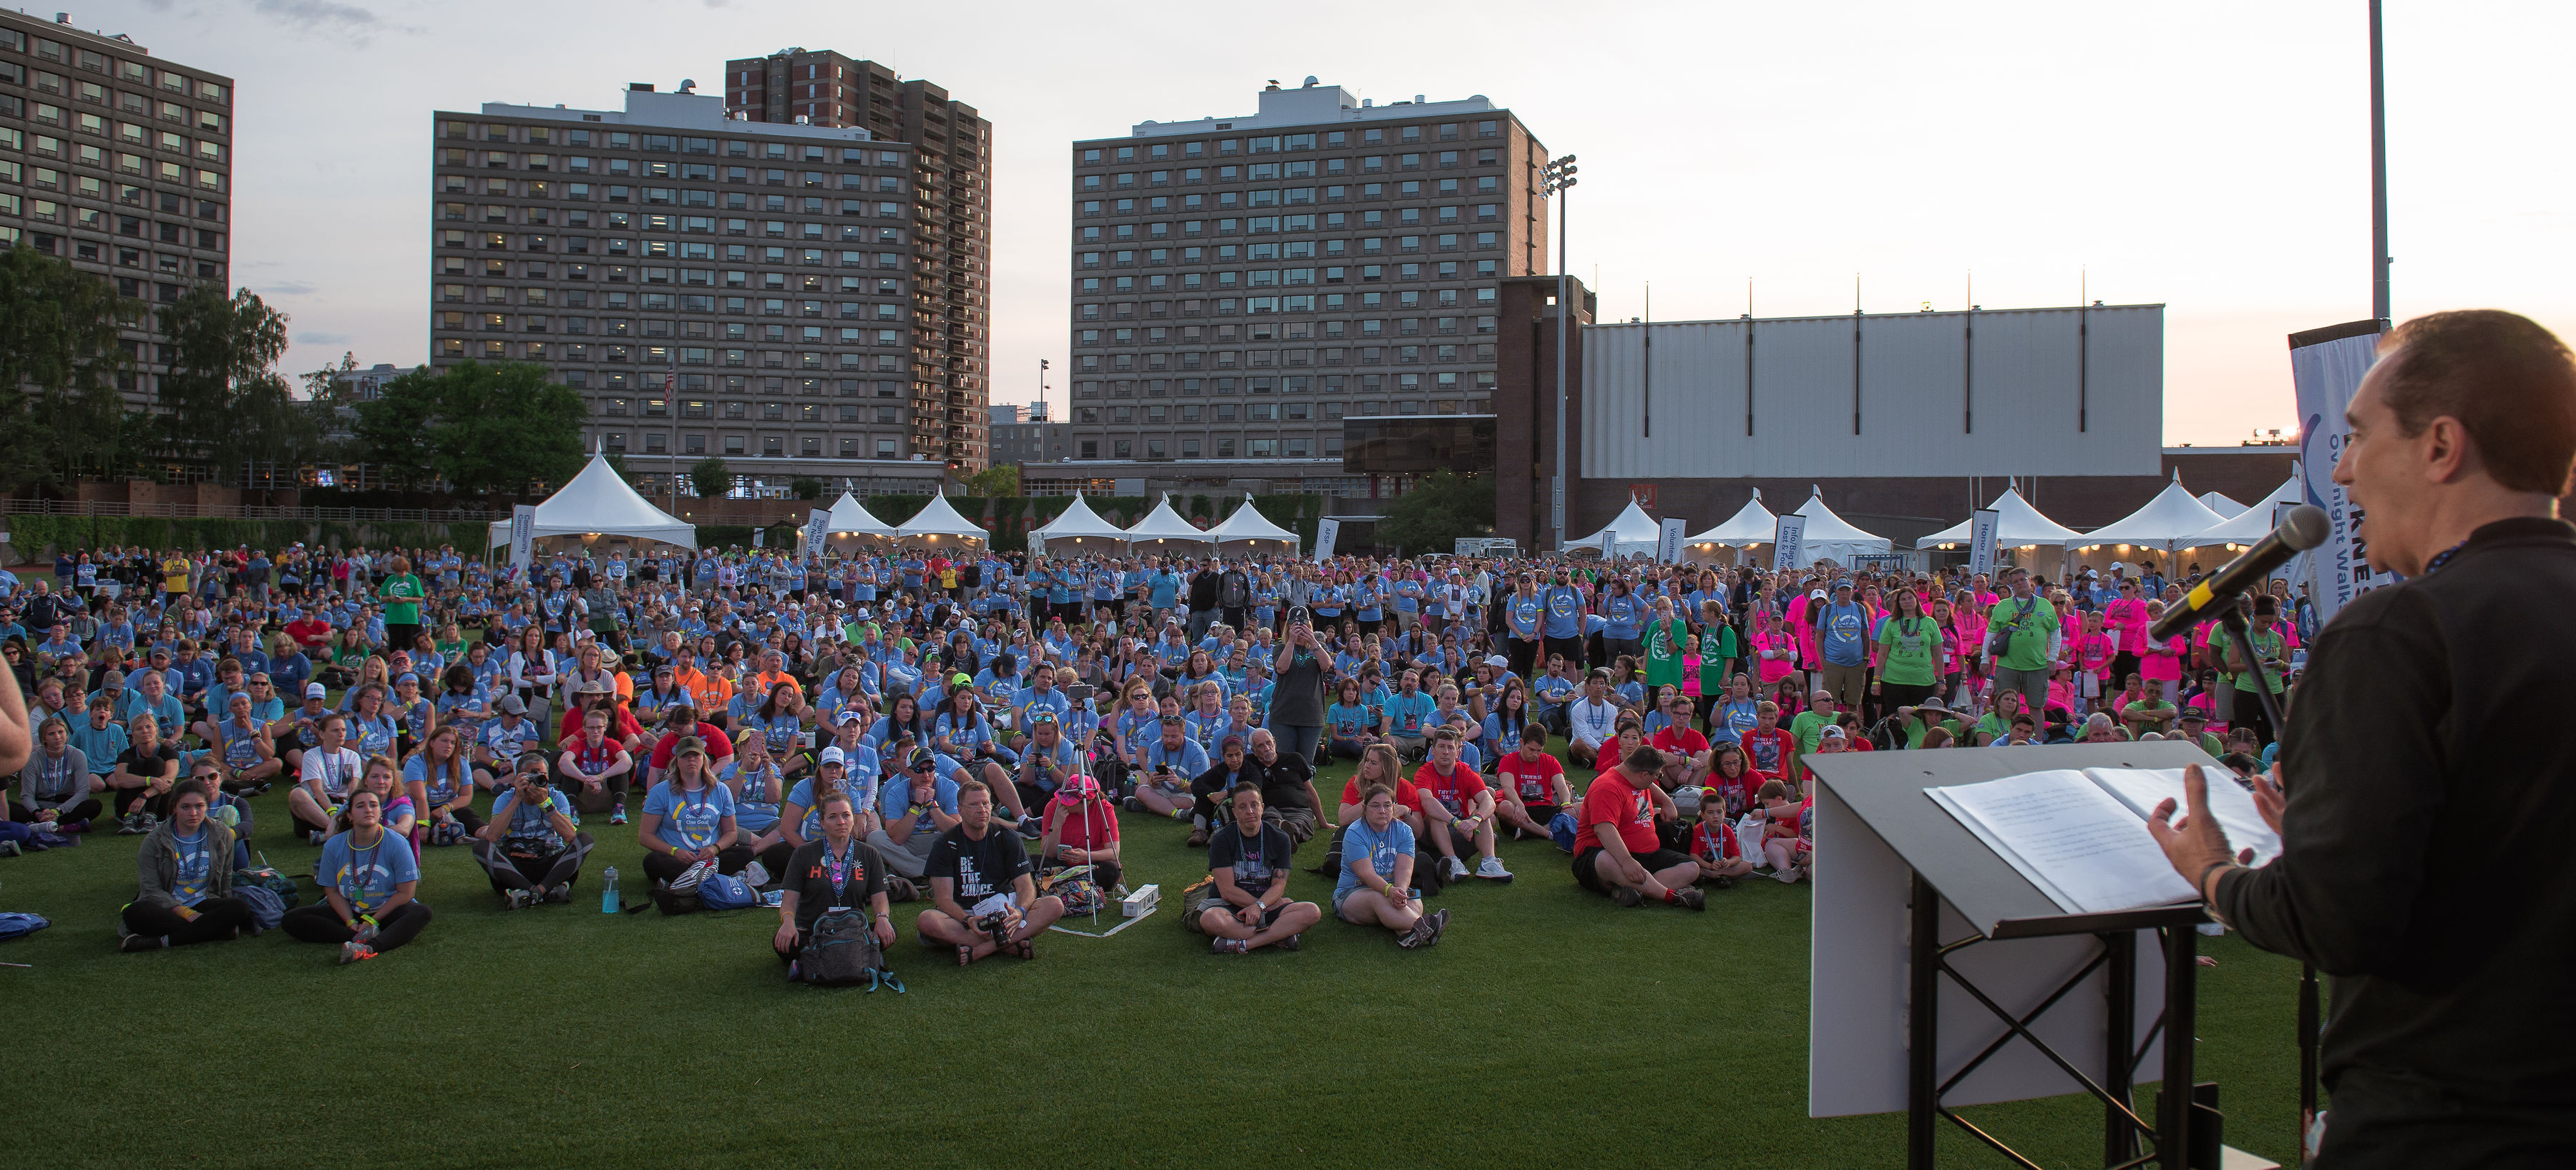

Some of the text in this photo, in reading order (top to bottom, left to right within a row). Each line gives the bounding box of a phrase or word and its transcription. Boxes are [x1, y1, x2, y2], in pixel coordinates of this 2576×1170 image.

[521, 514, 531, 554] Community
[809, 527, 818, 544] Next
[814, 519, 825, 545] Sign Up
[1782, 526, 1791, 543] Lost
[1980, 524, 1989, 550] Honor
[1787, 527, 1799, 560] Info/Bag
[960, 857, 974, 873] BE
[960, 872, 980, 884] THE
[961, 884, 993, 894] VOICE
